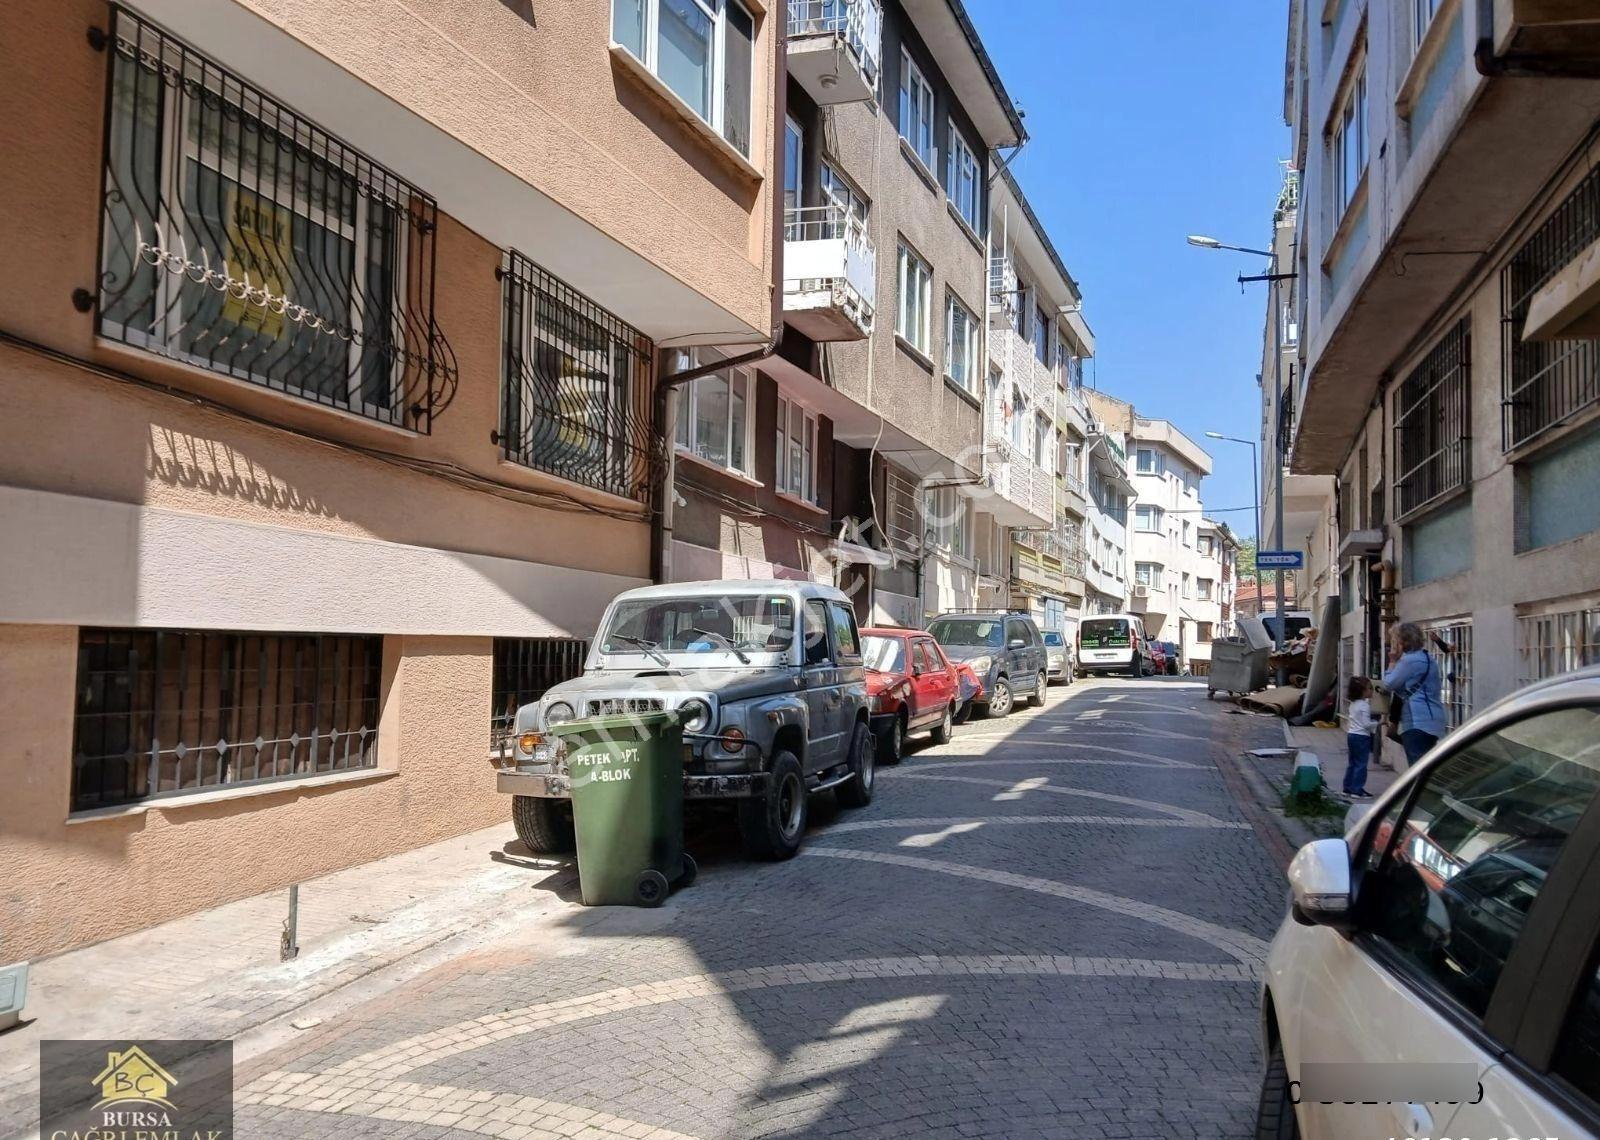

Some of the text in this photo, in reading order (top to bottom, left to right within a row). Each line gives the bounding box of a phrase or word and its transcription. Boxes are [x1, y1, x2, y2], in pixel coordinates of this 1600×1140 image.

[232, 201, 286, 246] ATILK
[577, 752, 612, 766] PETEK
[590, 768, 632, 783] A-BLOK
